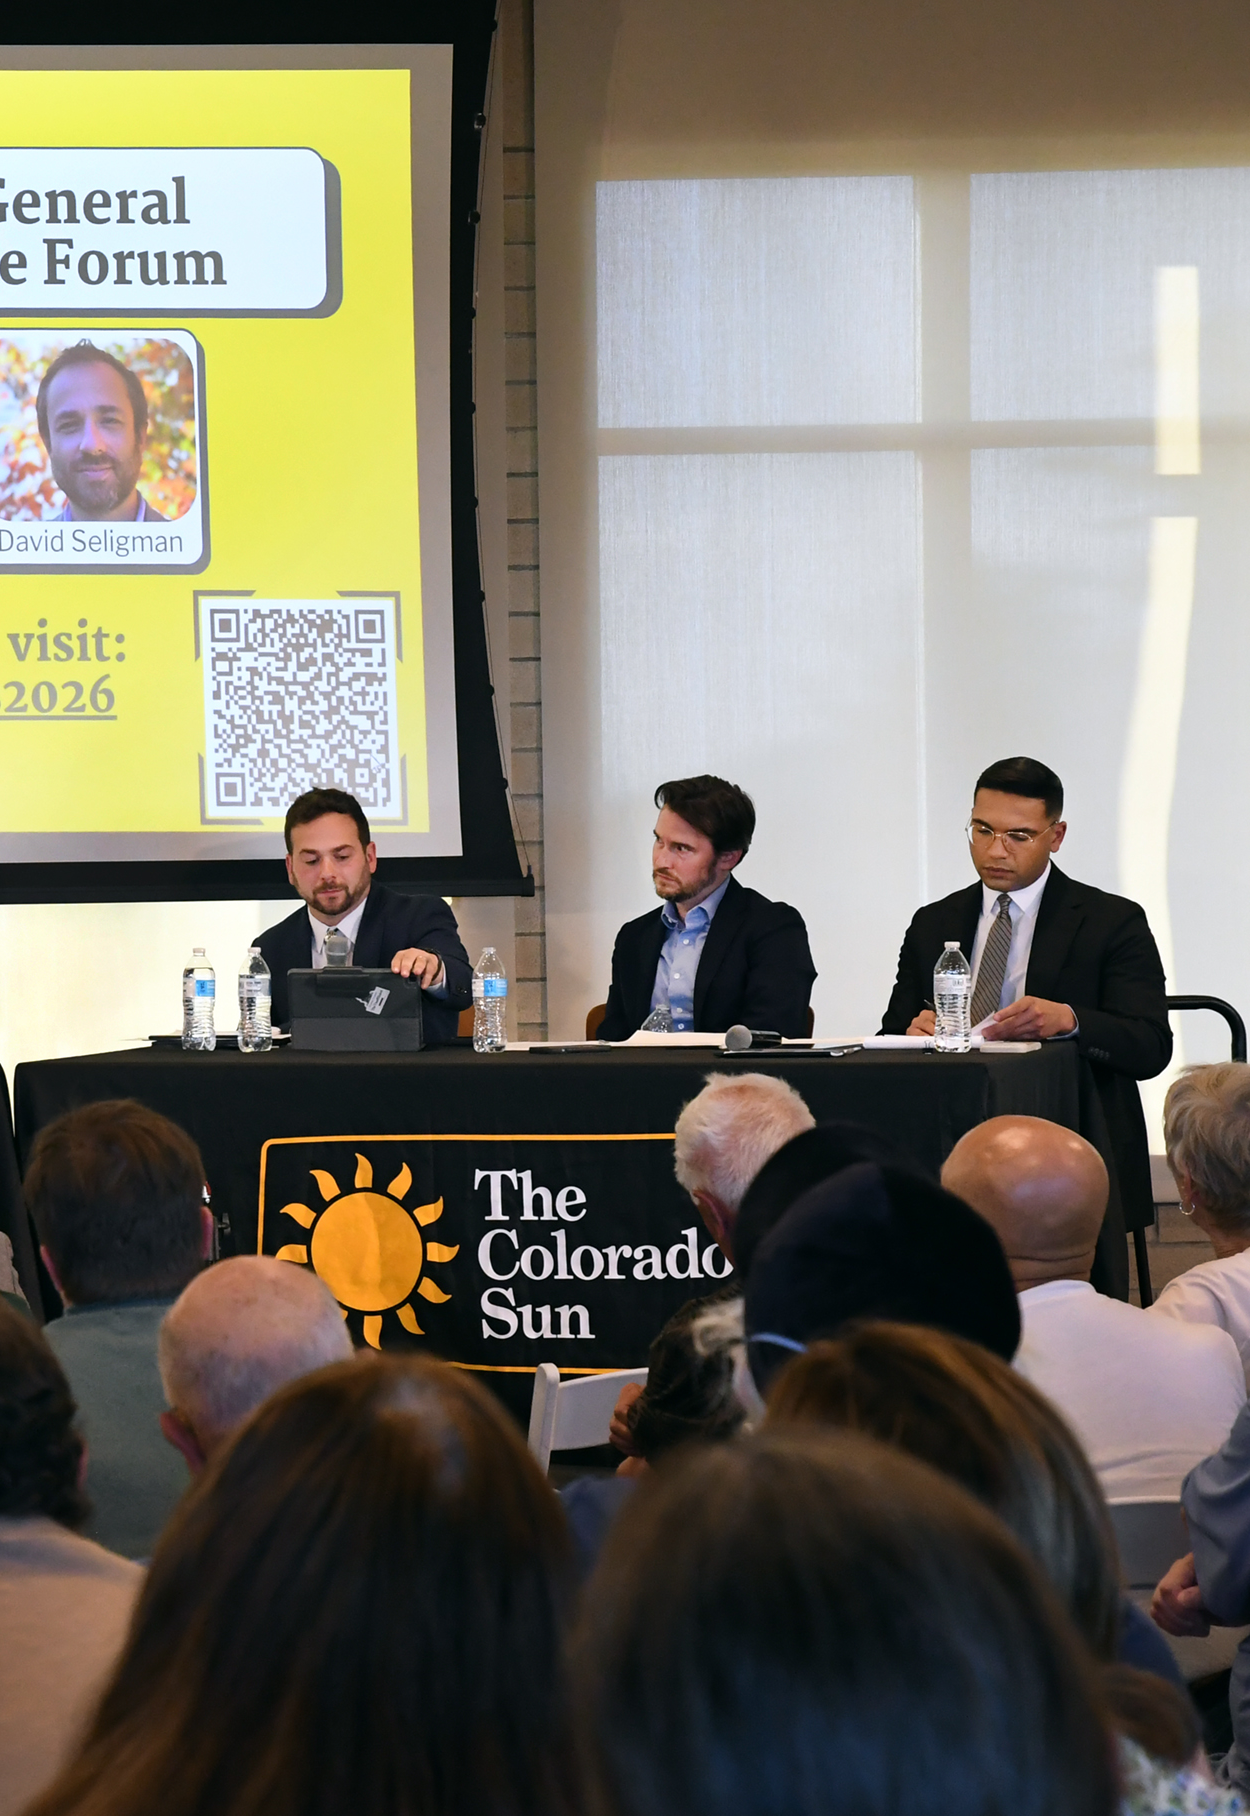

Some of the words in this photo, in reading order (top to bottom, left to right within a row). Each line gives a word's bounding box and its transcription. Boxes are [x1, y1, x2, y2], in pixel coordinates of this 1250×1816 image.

[42, 238, 227, 286] Forum
[72, 529, 183, 558] Seligman
[7, 619, 126, 663] visit:
[474, 1168, 587, 1222] The
[477, 1226, 734, 1281] Colorado
[480, 1287, 596, 1340] Sun
